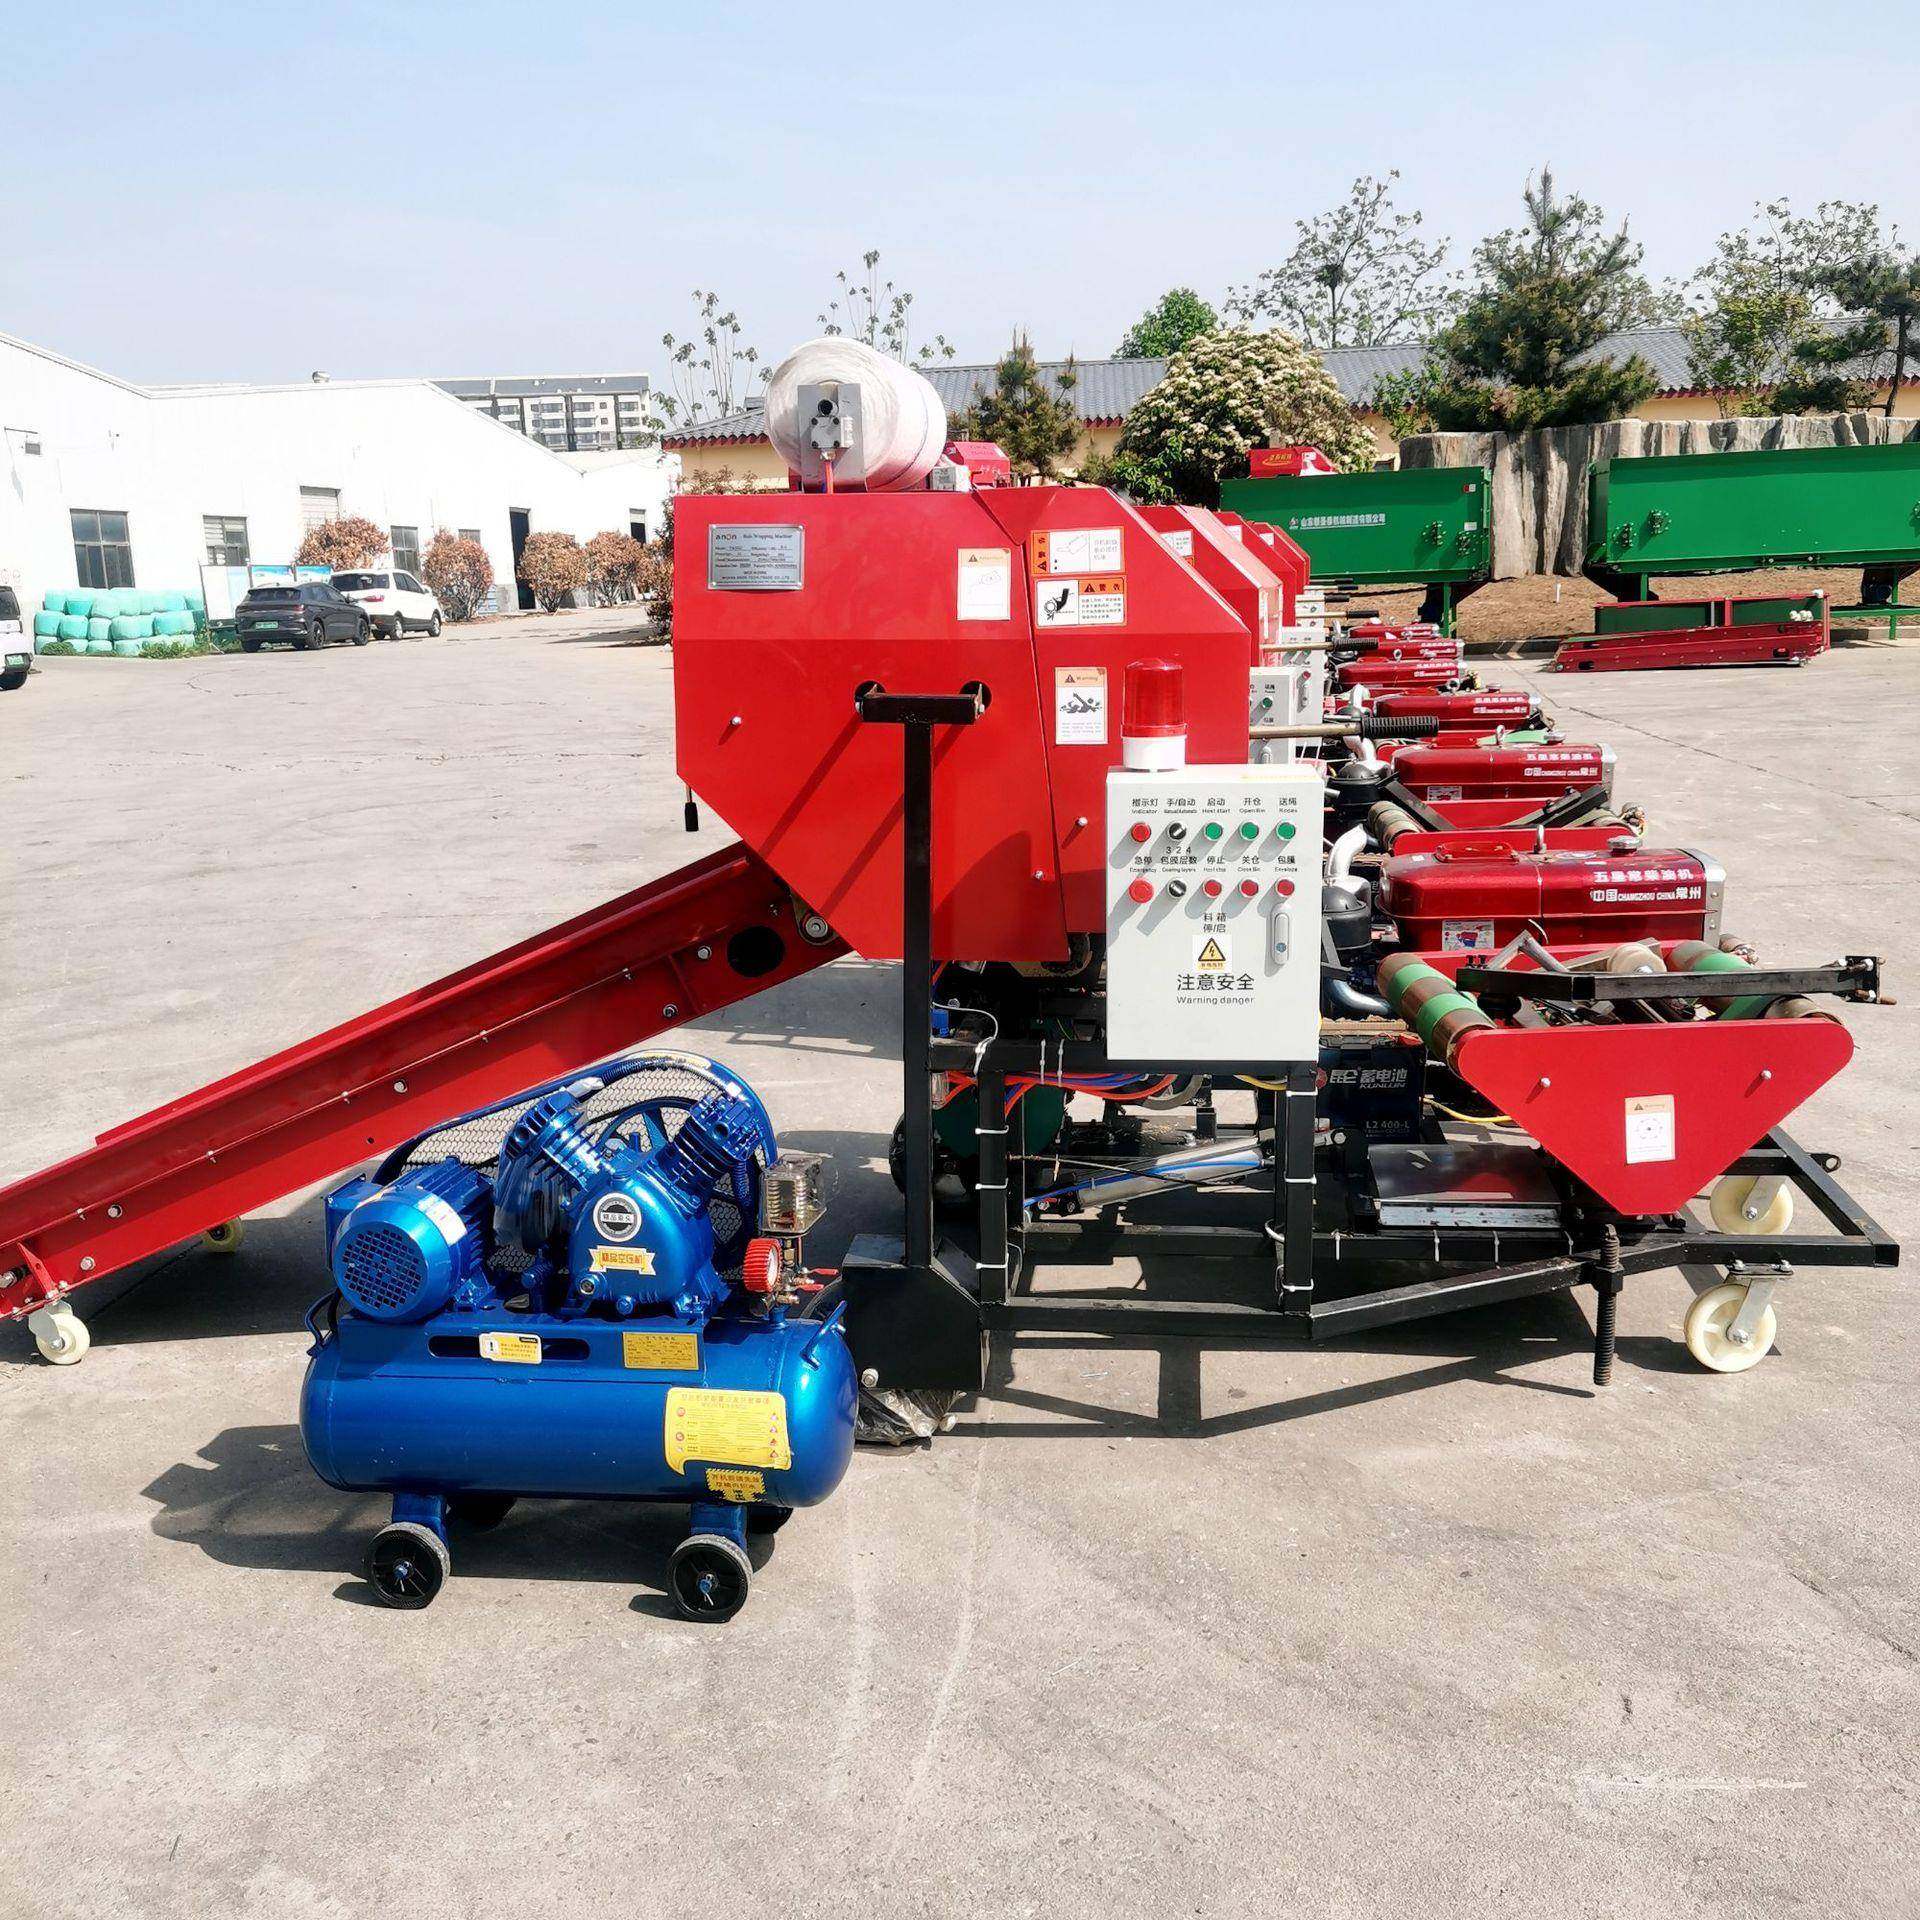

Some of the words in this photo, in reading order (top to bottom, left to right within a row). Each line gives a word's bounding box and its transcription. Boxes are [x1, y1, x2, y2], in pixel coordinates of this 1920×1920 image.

[1132, 798, 1158, 807] 指示灯
[1167, 798, 1196, 807] 手/自动
[1207, 797, 1226, 806] 启动
[1243, 797, 1261, 806] 开仓
[1166, 846, 1172, 854] 3
[1176, 846, 1182, 854] 2
[1186, 846, 1192, 854] 4
[1135, 856, 1153, 865] 急停
[1207, 855, 1226, 865] 停止
[1242, 855, 1260, 864] 关仓
[1592, 889, 1618, 902] 中国
[1676, 886, 1702, 900] 常州
[1203, 923, 1227, 933] 停/启
[1177, 973, 1254, 991] 注意安全
[1177, 996, 1218, 1005] Warning
[1220, 996, 1254, 1005] danger
